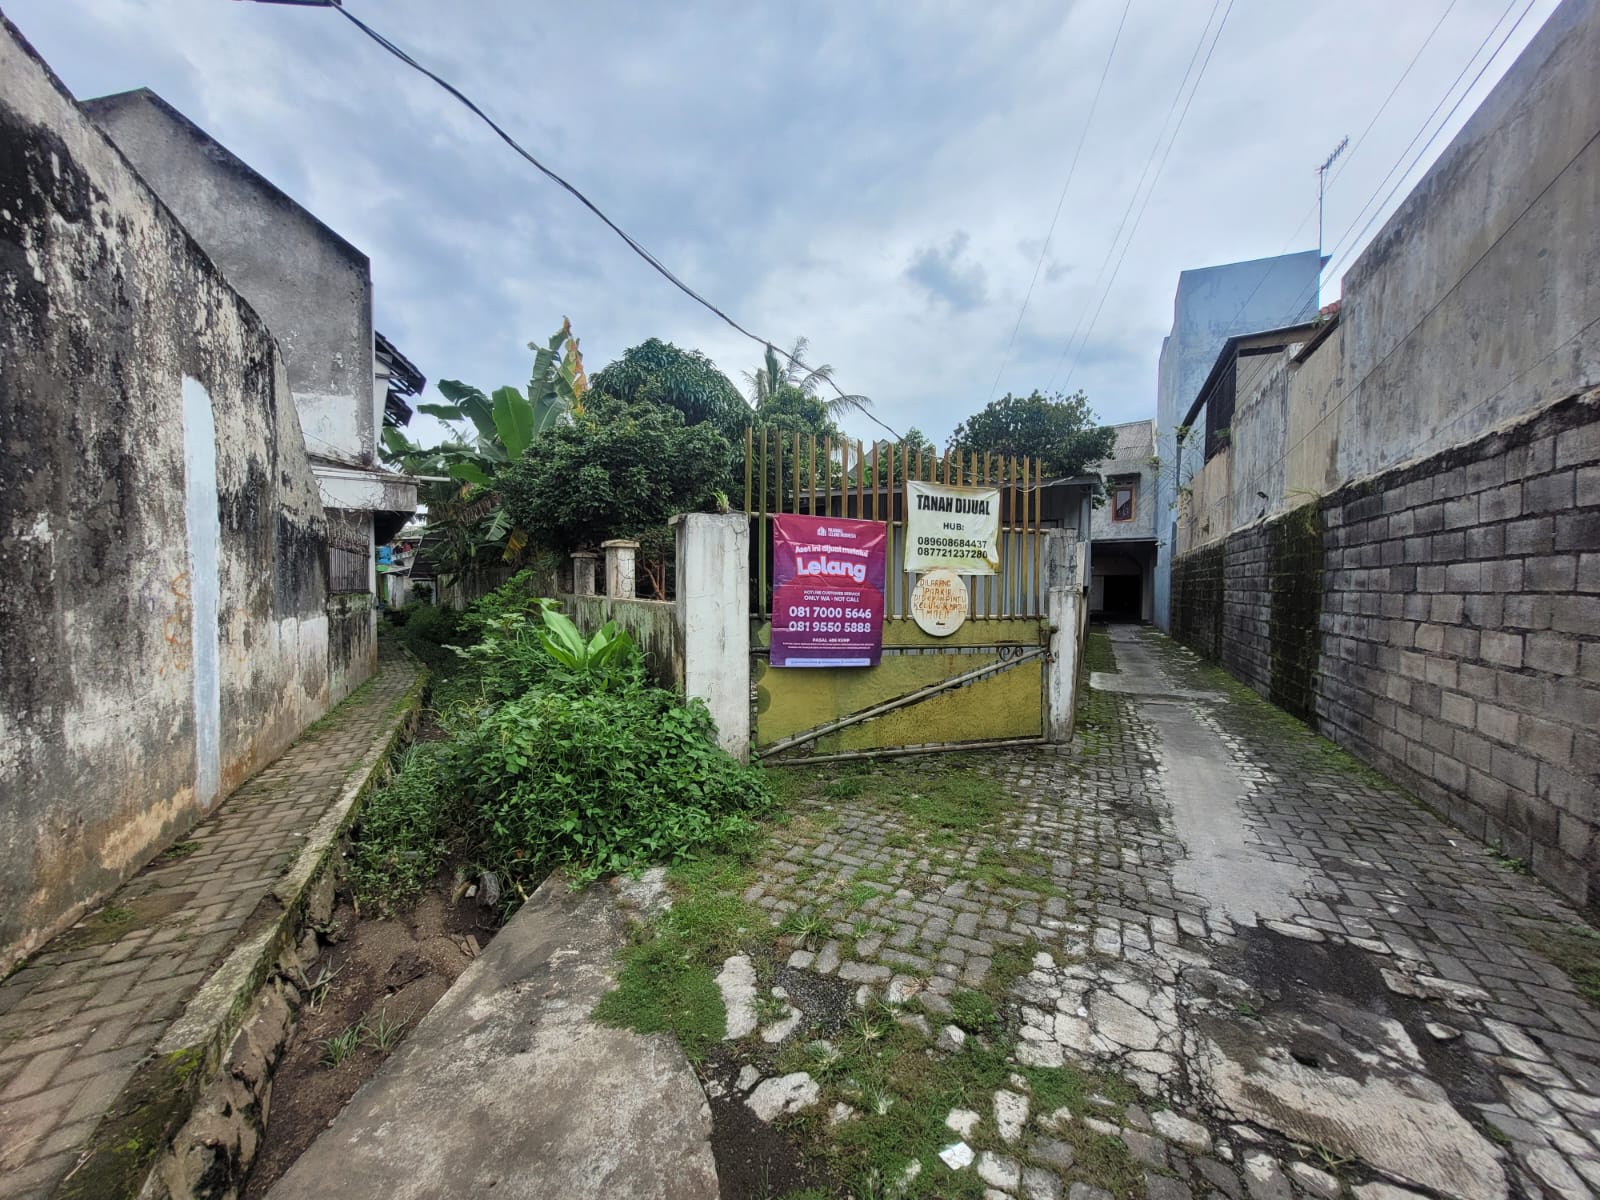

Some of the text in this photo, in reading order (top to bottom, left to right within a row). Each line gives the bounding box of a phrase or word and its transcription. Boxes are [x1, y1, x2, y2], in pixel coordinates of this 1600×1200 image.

[917, 494, 990, 515] TANAH DIJUAL
[943, 522, 964, 531] HUB:
[822, 545, 841, 553] dijual
[918, 537, 987, 549] 089608684437
[917, 548, 988, 559] 087721237280
[796, 556, 866, 583] Lelang
[789, 606, 872, 619] 081 7000 5646
[789, 621, 871, 633] 081 9550 5888
